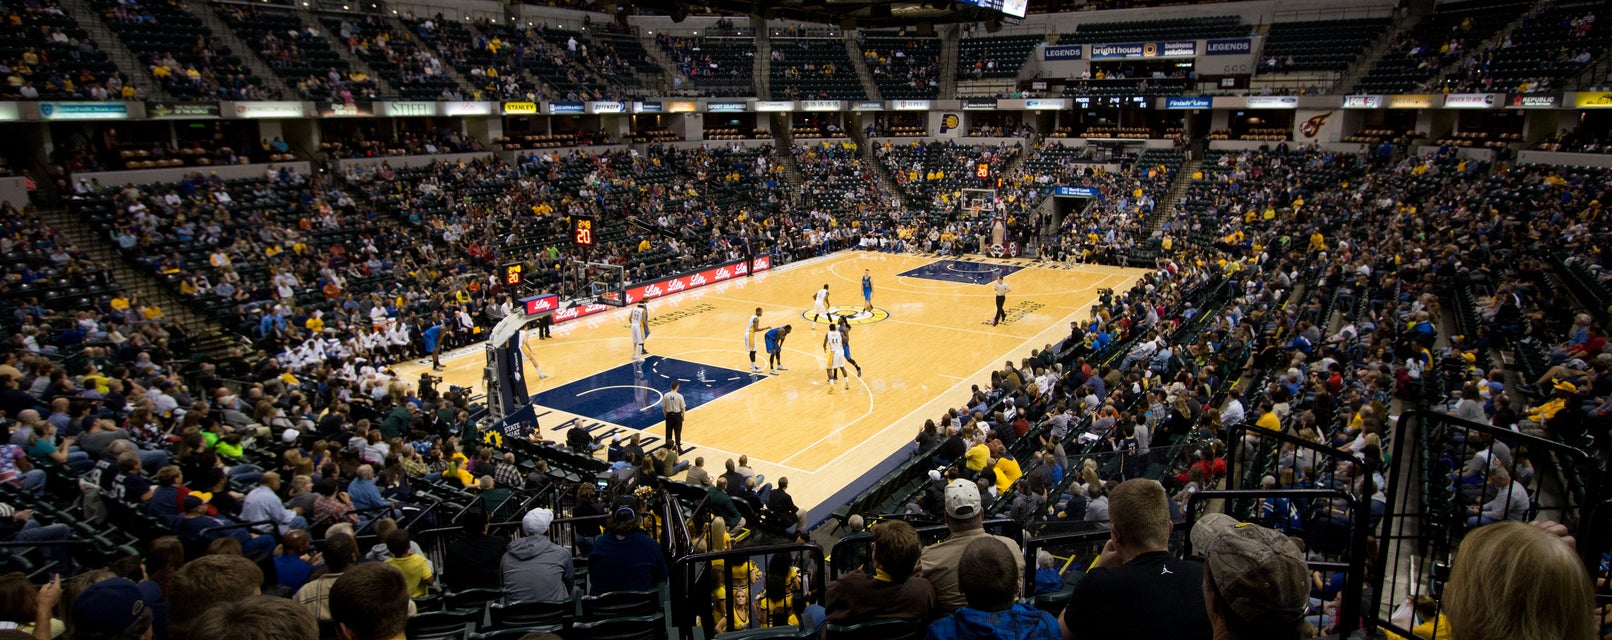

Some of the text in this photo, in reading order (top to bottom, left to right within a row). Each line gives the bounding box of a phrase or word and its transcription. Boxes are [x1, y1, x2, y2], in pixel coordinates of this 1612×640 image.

[1092, 46, 1142, 56] bright house
[1207, 42, 1249, 51] LEGENDS
[1045, 48, 1081, 57] LEGENDS
[1164, 48, 1194, 56] solutions
[977, 168, 987, 177] 20
[578, 219, 591, 229] 2:48
[577, 228, 591, 244] 20
[508, 273, 519, 284] 20
[643, 258, 768, 297] Lilly Lilly Lilly Lilly Lill Lilly
[534, 298, 551, 311] Lilly
[503, 422, 521, 434] STATE
